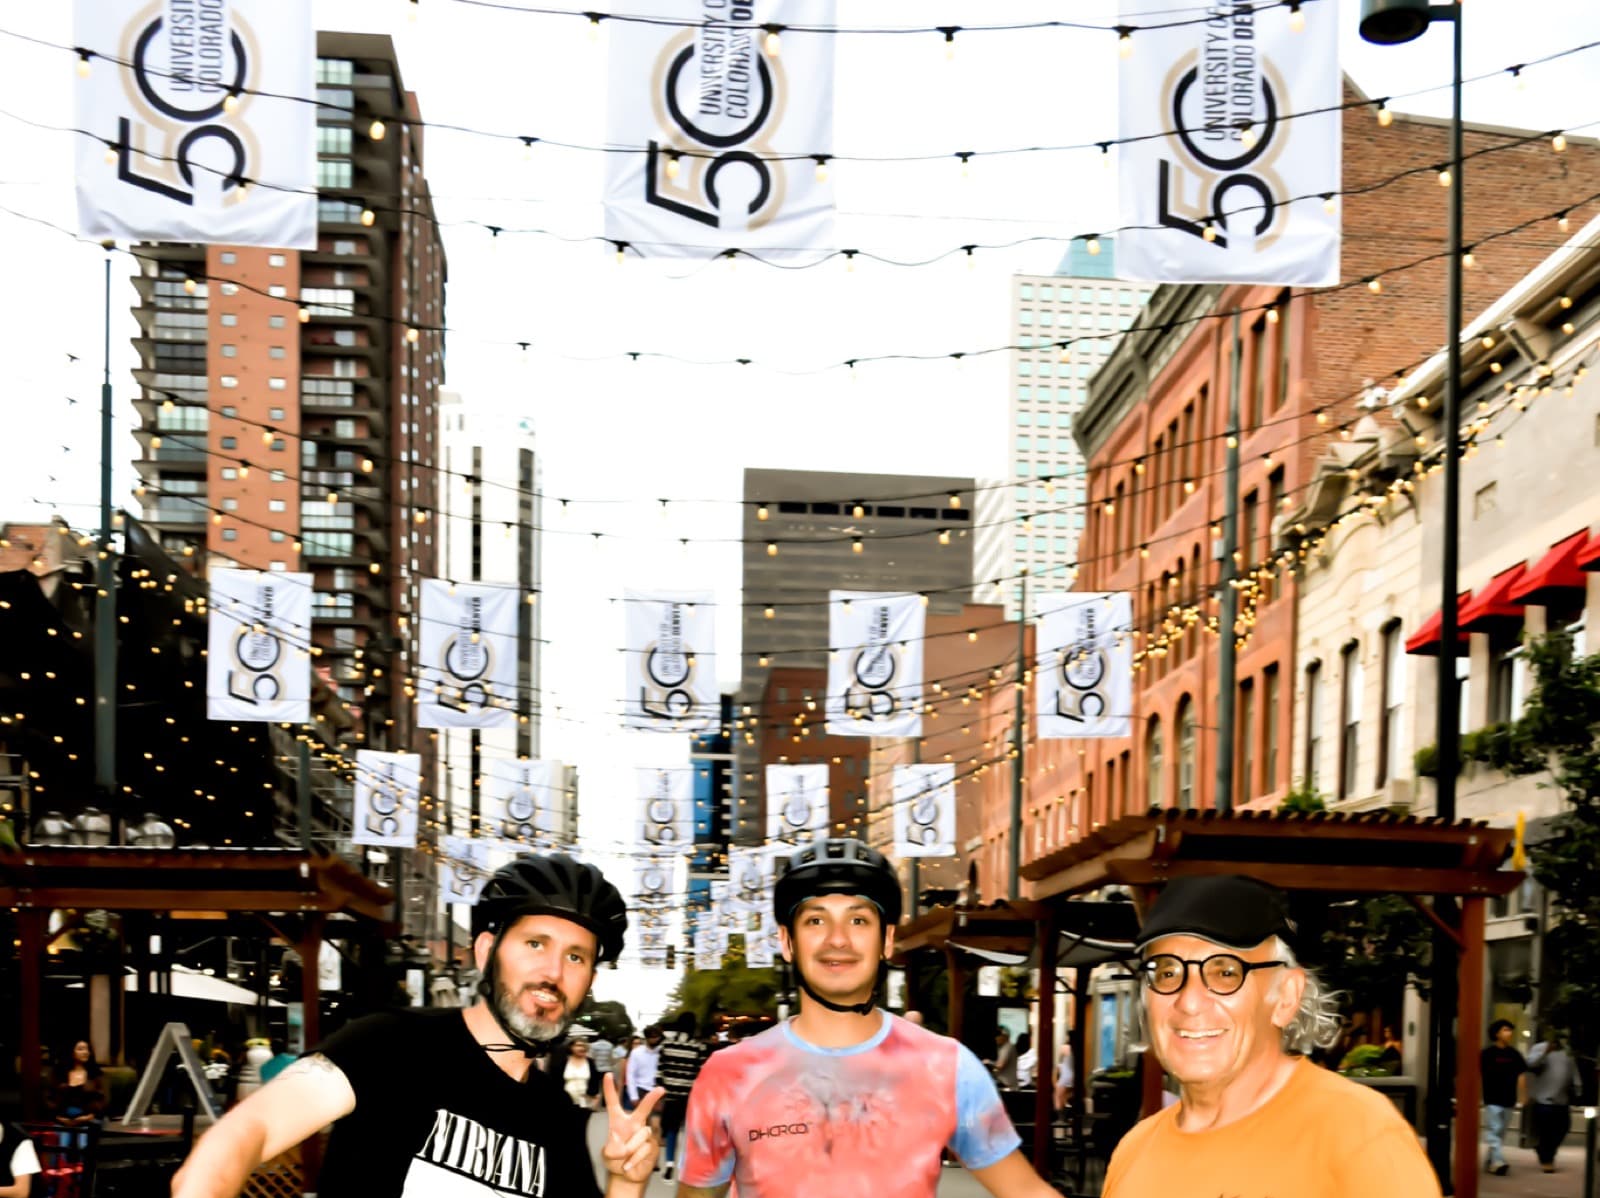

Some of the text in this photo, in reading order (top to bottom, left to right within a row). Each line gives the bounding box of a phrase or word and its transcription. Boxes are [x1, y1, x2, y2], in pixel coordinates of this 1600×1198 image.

[699, 14, 727, 115] UNIVERSITY
[1204, 33, 1229, 141] UNIVERSITY
[118, 15, 253, 207] 50
[646, 42, 780, 229] 50
[1159, 64, 1284, 249] 50
[228, 627, 284, 706] 50
[437, 639, 491, 713] 50
[641, 647, 694, 720] 50
[844, 650, 898, 721] 50
[1055, 651, 1108, 723] 50
[416, 1108, 547, 1198] NIRVANA
